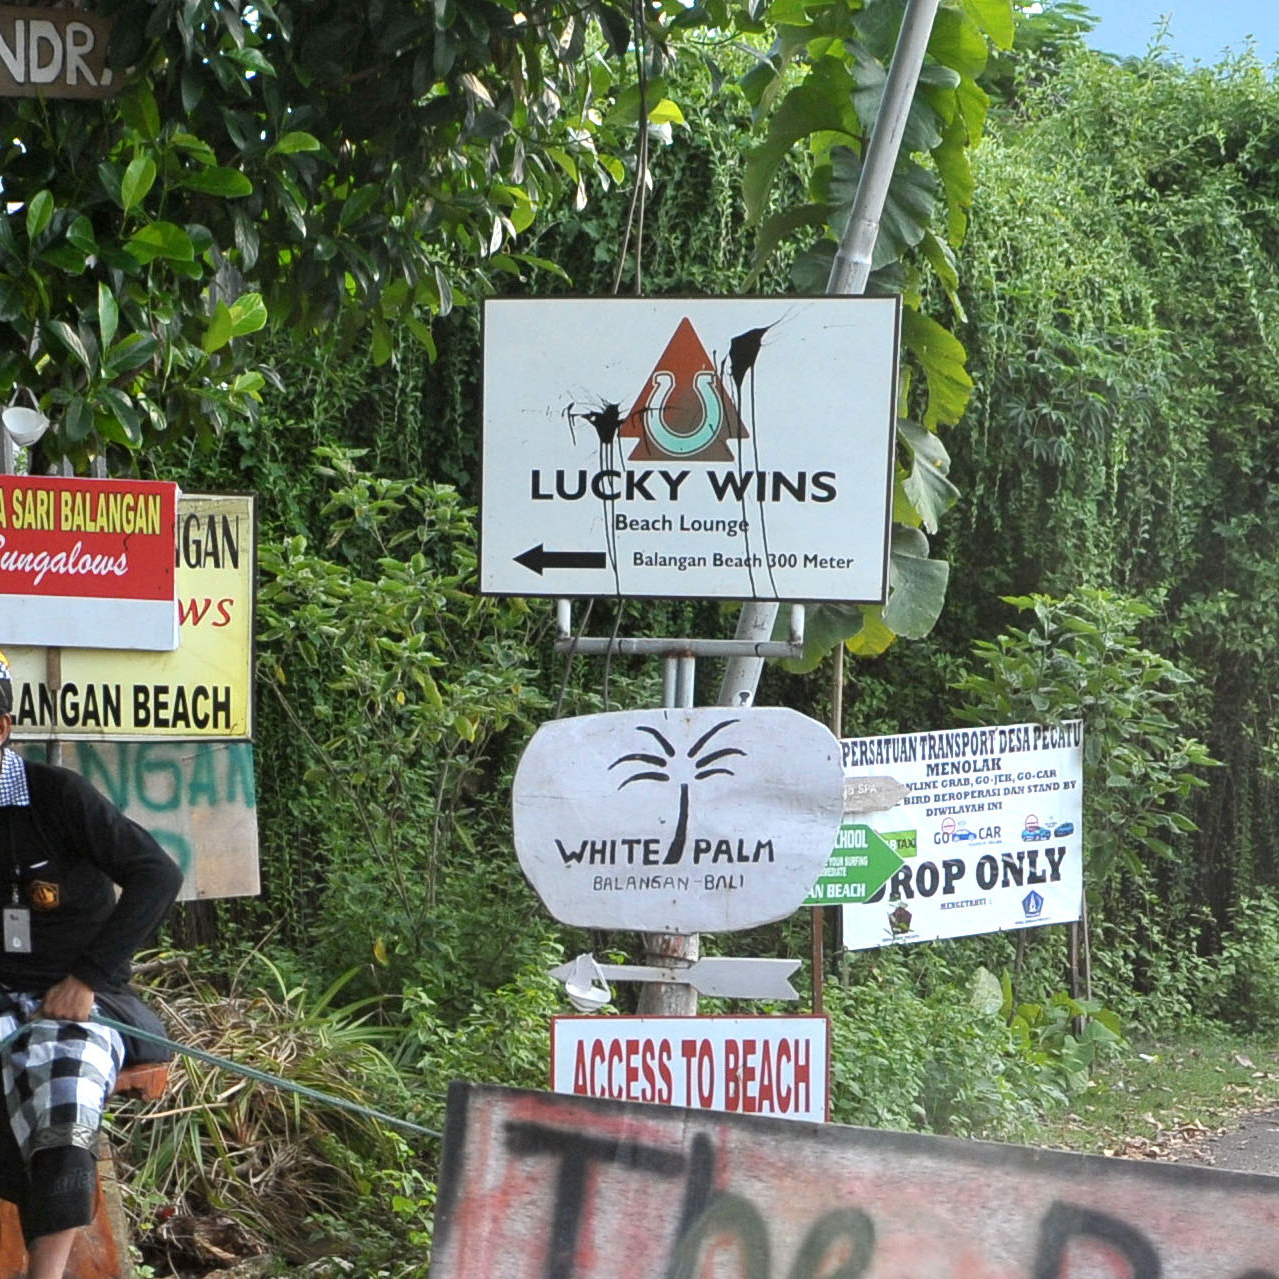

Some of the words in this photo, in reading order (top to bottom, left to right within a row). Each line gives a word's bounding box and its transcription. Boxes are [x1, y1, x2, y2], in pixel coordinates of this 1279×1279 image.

[531, 469, 691, 501] LUCKY
[707, 470, 838, 503] WINS
[11, 488, 55, 532] SARI
[60, 490, 162, 535] BALANGAN
[615, 513, 673, 532] Beach
[679, 514, 750, 537] Lounge
[176, 513, 240, 569] GAN
[633, 551, 707, 571] Balangan
[712, 552, 762, 569] Beach
[767, 553, 797, 570] 300
[803, 554, 854, 570] Meter
[11, 682, 121, 728] ANGAN
[133, 685, 232, 729] BEACH
[841, 739, 918, 768] PERSATUAN
[920, 729, 997, 761] TRANSPORT
[998, 725, 1031, 754] DESA
[1032, 721, 1082, 750] PECATU
[904, 779, 939, 792] NLINE
[1017, 769, 1057, 782] GO-CAR
[926, 757, 1002, 778] MENOLAK
[903, 794, 930, 807] BIRD
[933, 788, 1001, 803] BEROPERASI
[1003, 786, 1025, 797] DAN
[1025, 783, 1060, 795] STAND
[1063, 780, 1077, 790] BY
[926, 803, 985, 817] DIWILAYAH
[987, 801, 1003, 811] INI
[934, 832, 950, 845] GO
[978, 826, 1002, 840] CAR
[554, 838, 661, 866] WHITE
[693, 838, 775, 864] PALM
[975, 846, 1067, 891] ONLY
[827, 882, 866, 898] BEACH
[574, 1038, 672, 1104] ACCESS
[681, 1038, 715, 1109] TO
[724, 1037, 811, 1113] BEACH
